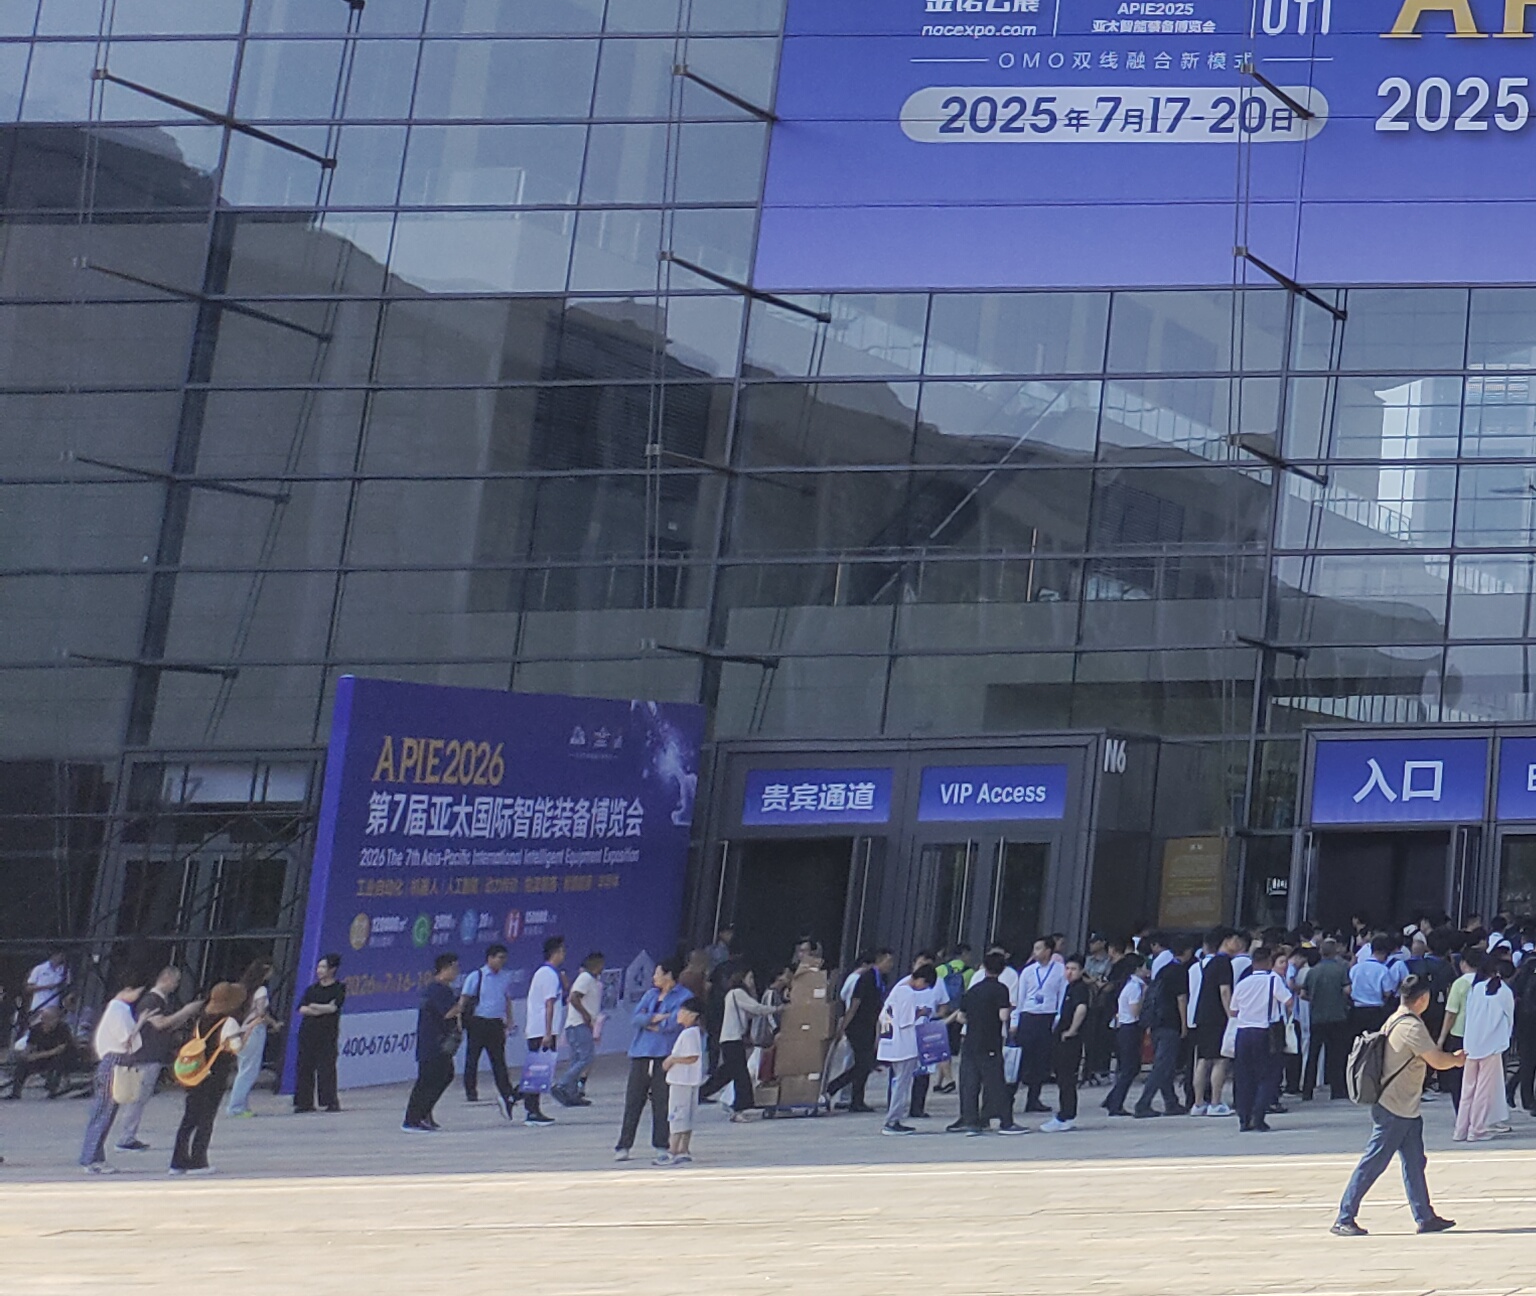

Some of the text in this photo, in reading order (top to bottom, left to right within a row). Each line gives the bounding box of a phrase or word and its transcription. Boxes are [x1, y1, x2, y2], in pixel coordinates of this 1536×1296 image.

[1117, 2, 1195, 16] APIE2025
[921, 23, 1037, 39] nocexpo.com
[1091, 19, 1217, 34] 亚太智能装备博览会
[1376, 77, 1529, 133] 2025
[371, 735, 505, 786] APIE2026
[1103, 738, 1126, 774] N6
[761, 782, 876, 813] 贵宾通道
[939, 782, 1047, 805] VIP Access
[1353, 758, 1444, 804] 入口
[364, 789, 645, 840] 第7届亚太国际智能装备博览会
